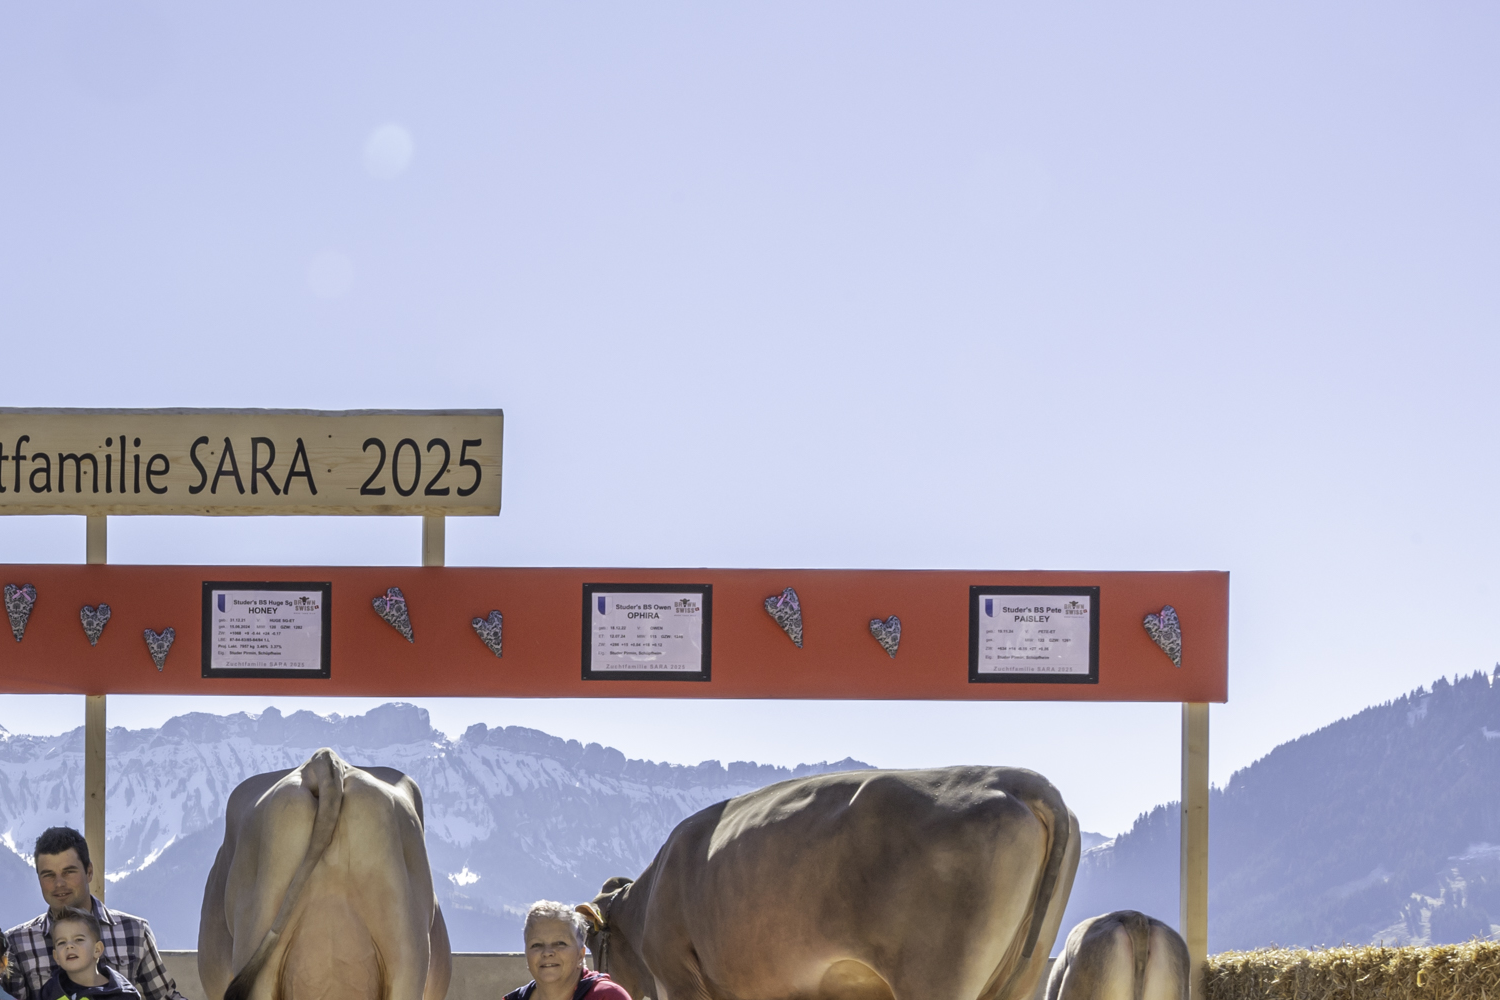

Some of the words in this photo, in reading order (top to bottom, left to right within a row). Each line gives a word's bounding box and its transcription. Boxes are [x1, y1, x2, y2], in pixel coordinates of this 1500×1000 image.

[188, 435, 318, 496] SARA
[359, 437, 483, 497] 2025
[1014, 615, 1050, 623] PAISLEY
